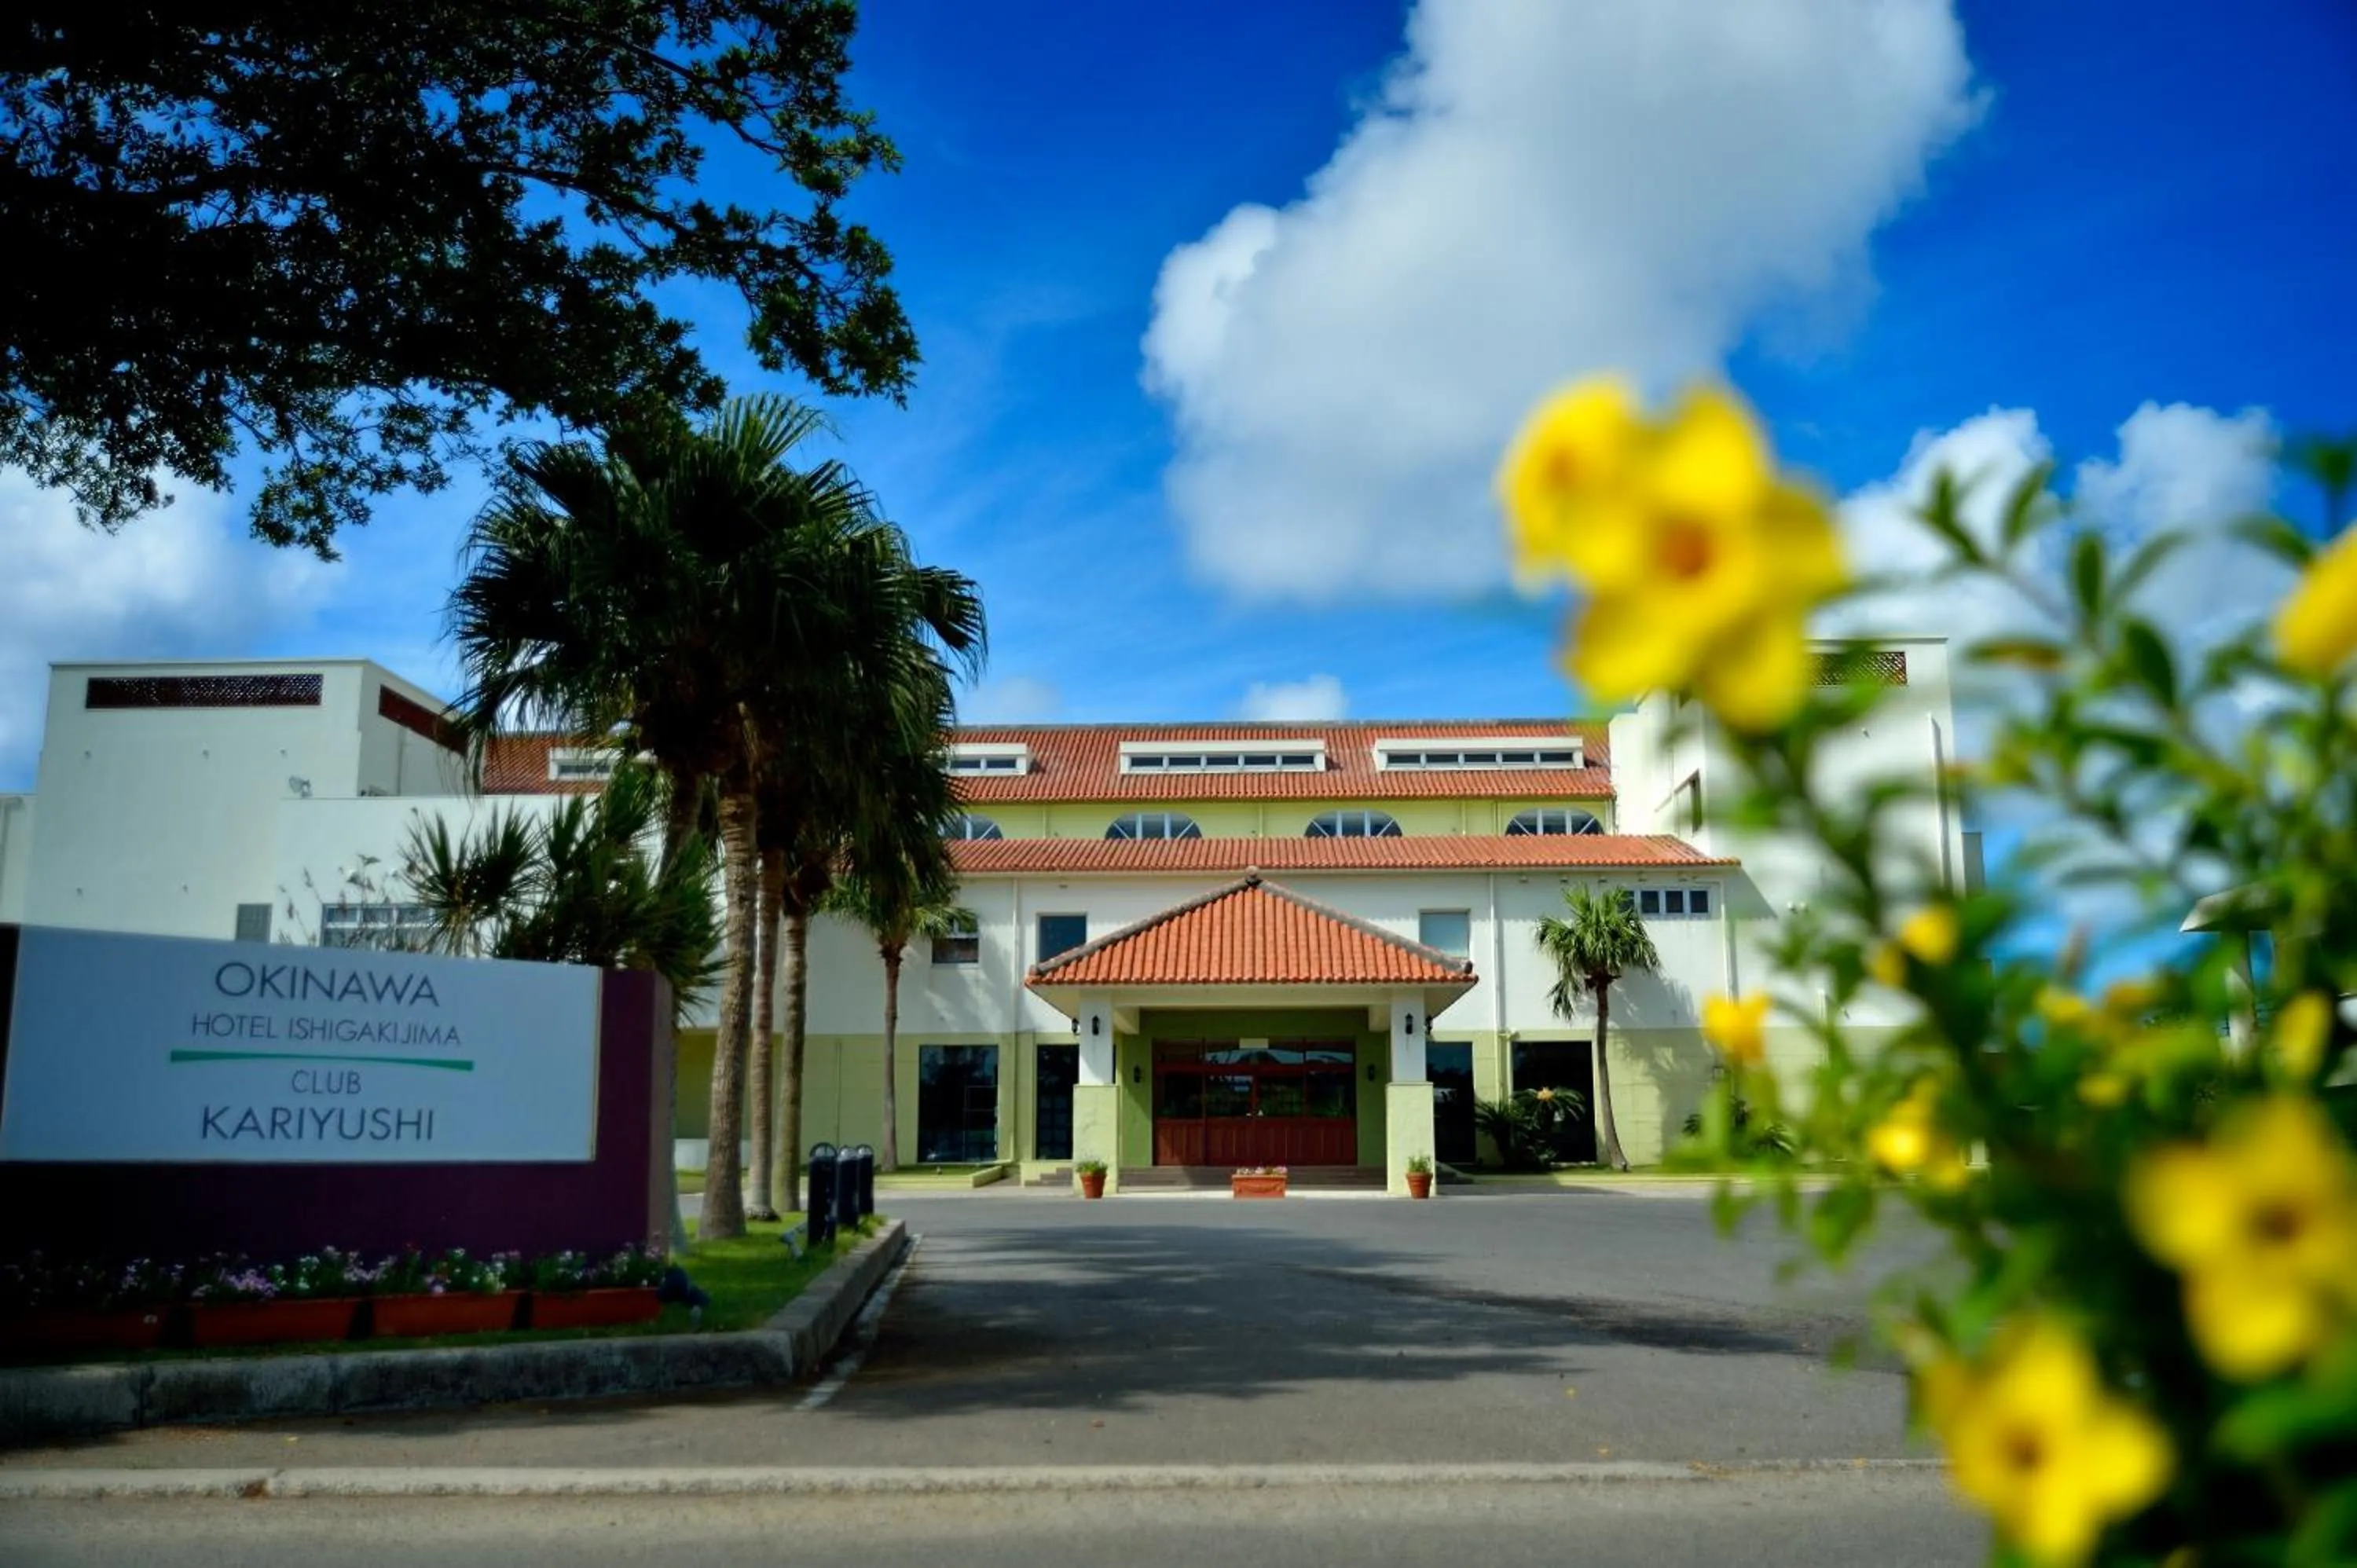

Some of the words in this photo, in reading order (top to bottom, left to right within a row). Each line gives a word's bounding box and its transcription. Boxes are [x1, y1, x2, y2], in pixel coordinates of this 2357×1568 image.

[214, 962, 440, 1007] OKINAWA
[192, 1013, 278, 1039] HOTEL
[288, 1017, 462, 1046] ISHIGAKIJIMA
[291, 1069, 361, 1095] CLUB
[201, 1105, 434, 1141] KARIYUSHI
